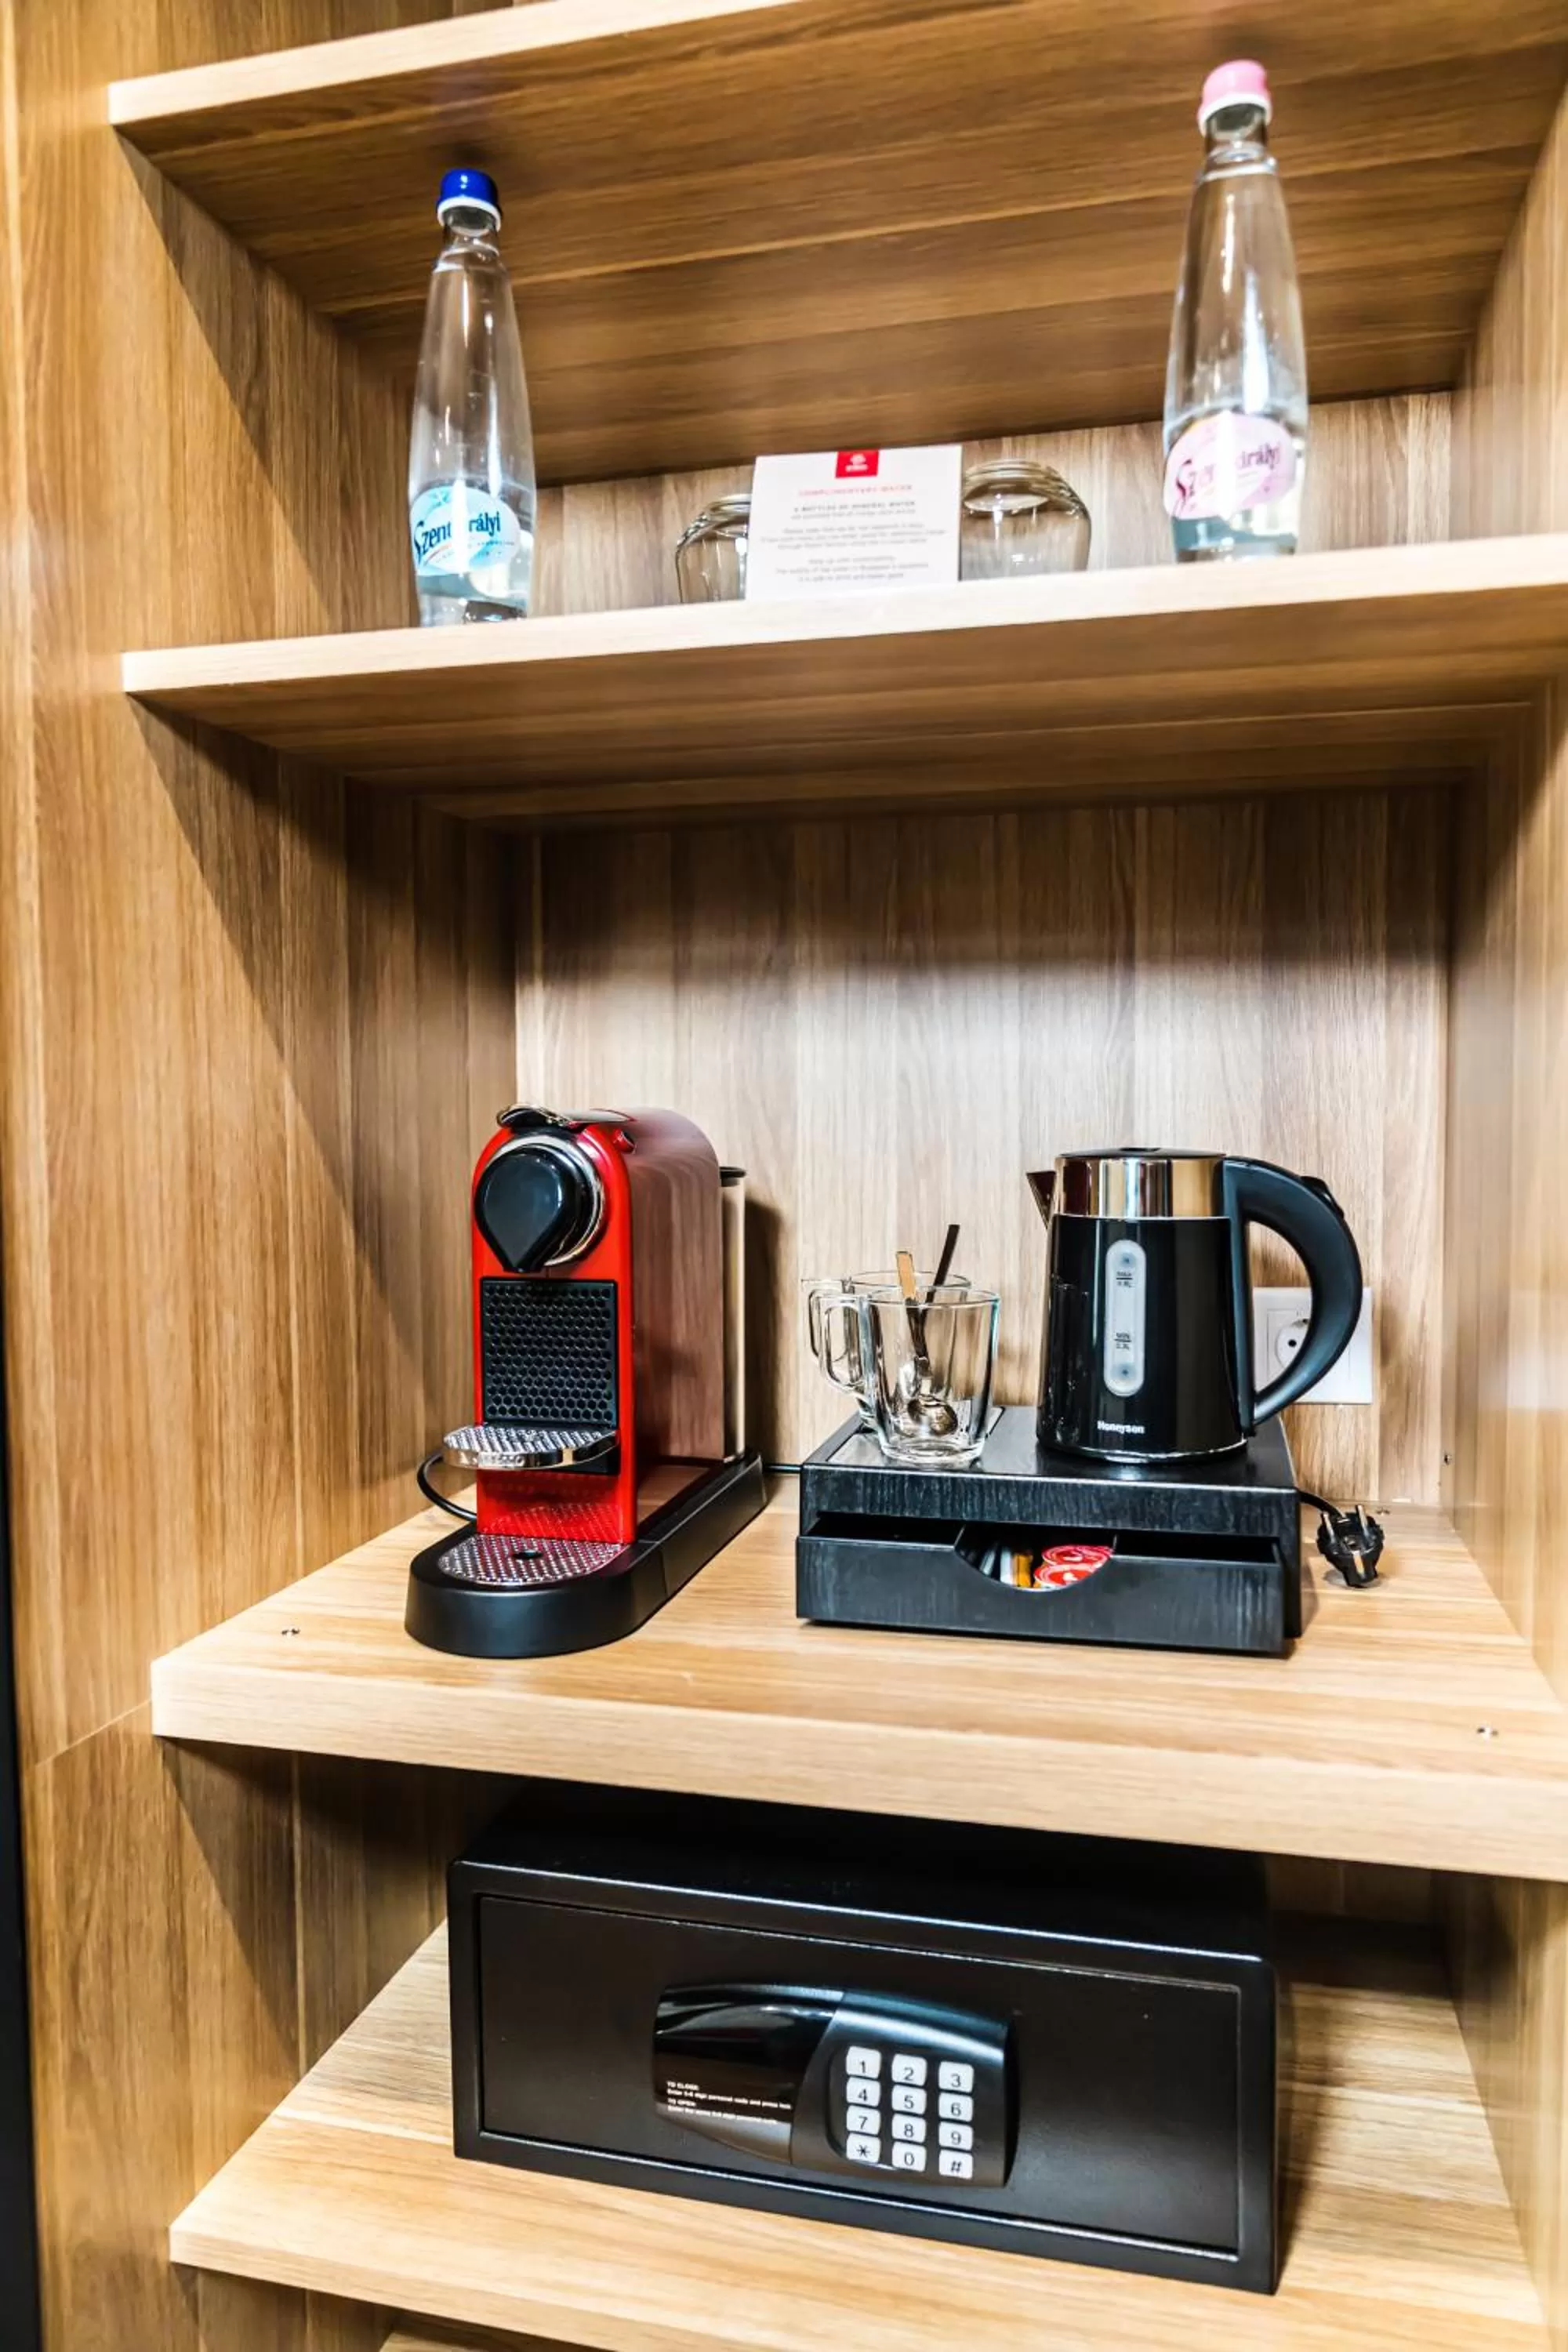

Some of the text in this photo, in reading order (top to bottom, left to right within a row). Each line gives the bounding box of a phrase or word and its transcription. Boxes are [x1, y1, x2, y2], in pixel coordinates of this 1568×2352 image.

[413, 510, 502, 565] Szentrályi
[859, 2060, 961, 2088] 1 2 3
[858, 2088, 961, 2117] 4 5 6
[858, 2115, 961, 2145] 7 8 9
[904, 2151, 915, 2166] 0
[950, 2160, 962, 2173] #
